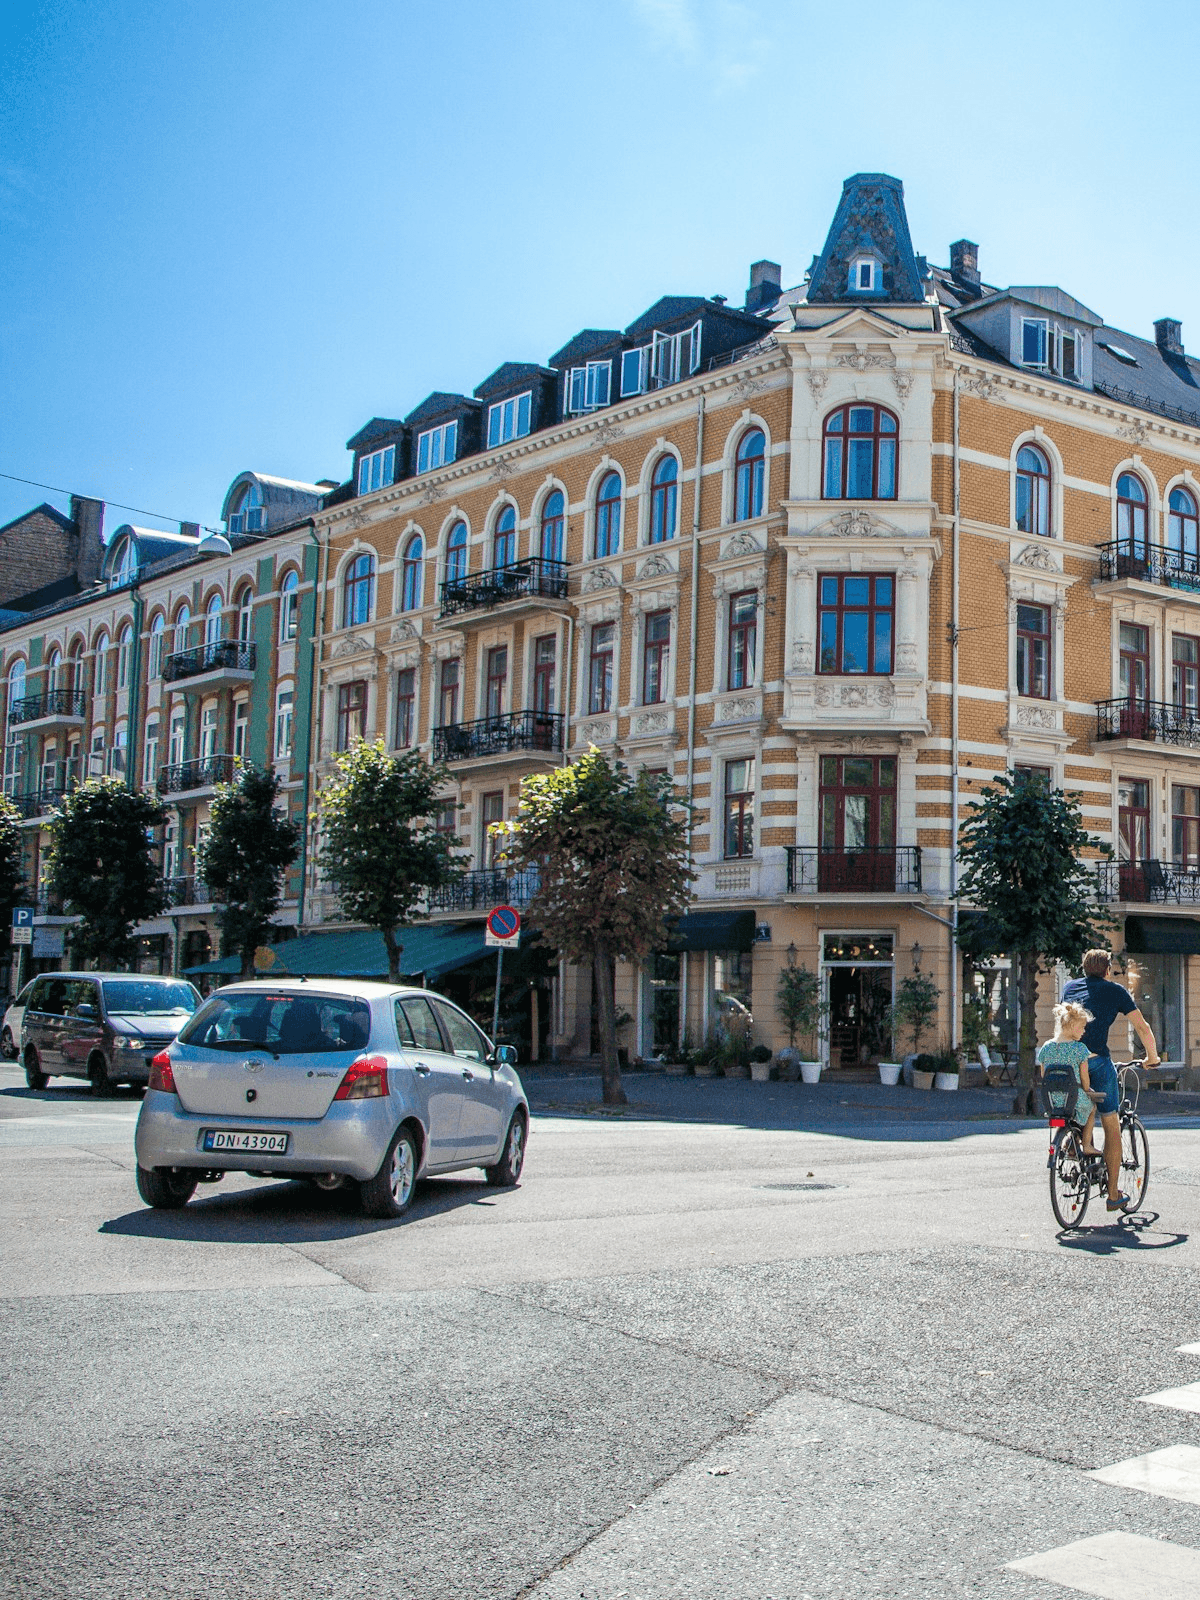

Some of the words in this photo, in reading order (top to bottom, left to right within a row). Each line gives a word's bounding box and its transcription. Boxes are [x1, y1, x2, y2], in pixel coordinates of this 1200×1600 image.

[18, 910, 28, 924] P
[216, 1134, 236, 1147] DN
[242, 1135, 285, 1149] 43904
